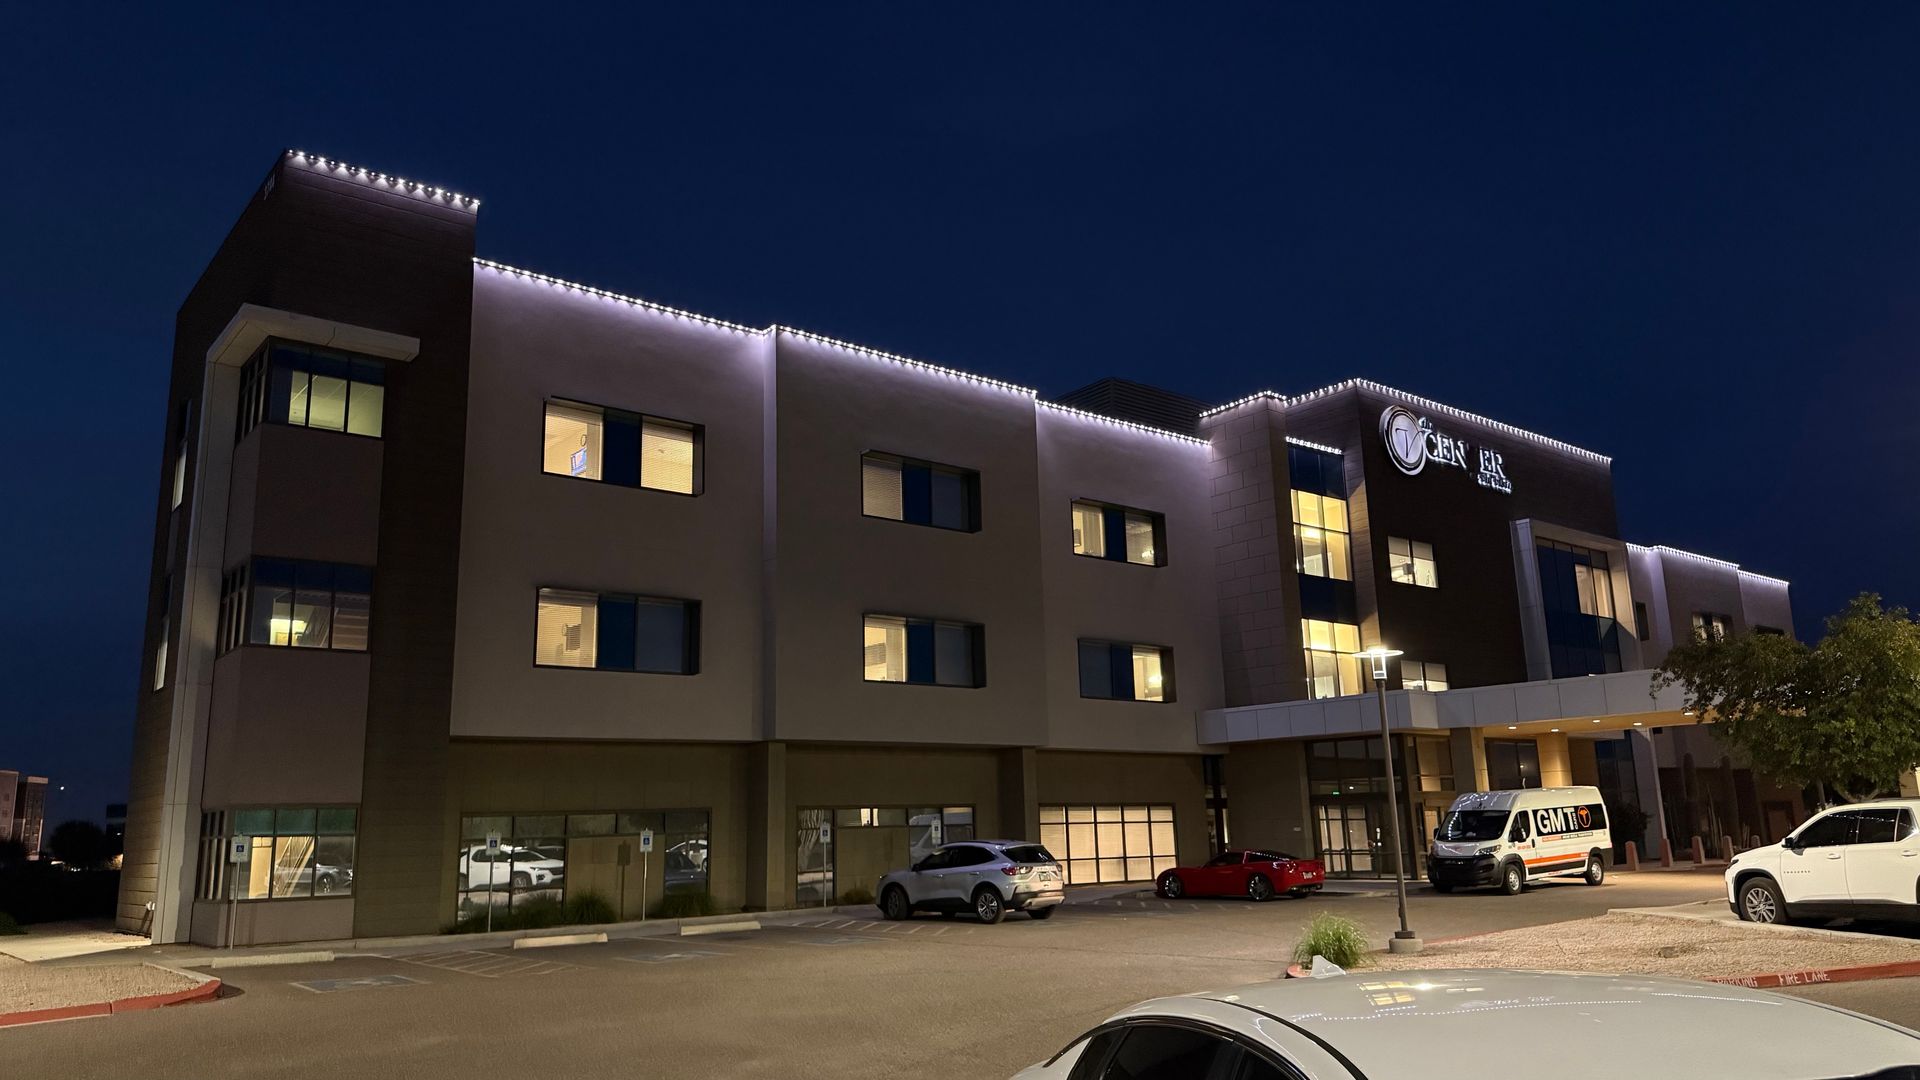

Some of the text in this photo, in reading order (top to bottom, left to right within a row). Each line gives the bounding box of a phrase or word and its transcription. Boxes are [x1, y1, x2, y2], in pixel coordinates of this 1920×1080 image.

[1424, 429, 1506, 478] CENER
[1536, 807, 1575, 834] GMT
[1778, 973, 1802, 986] FIRE
[1804, 970, 1831, 982] LANE
